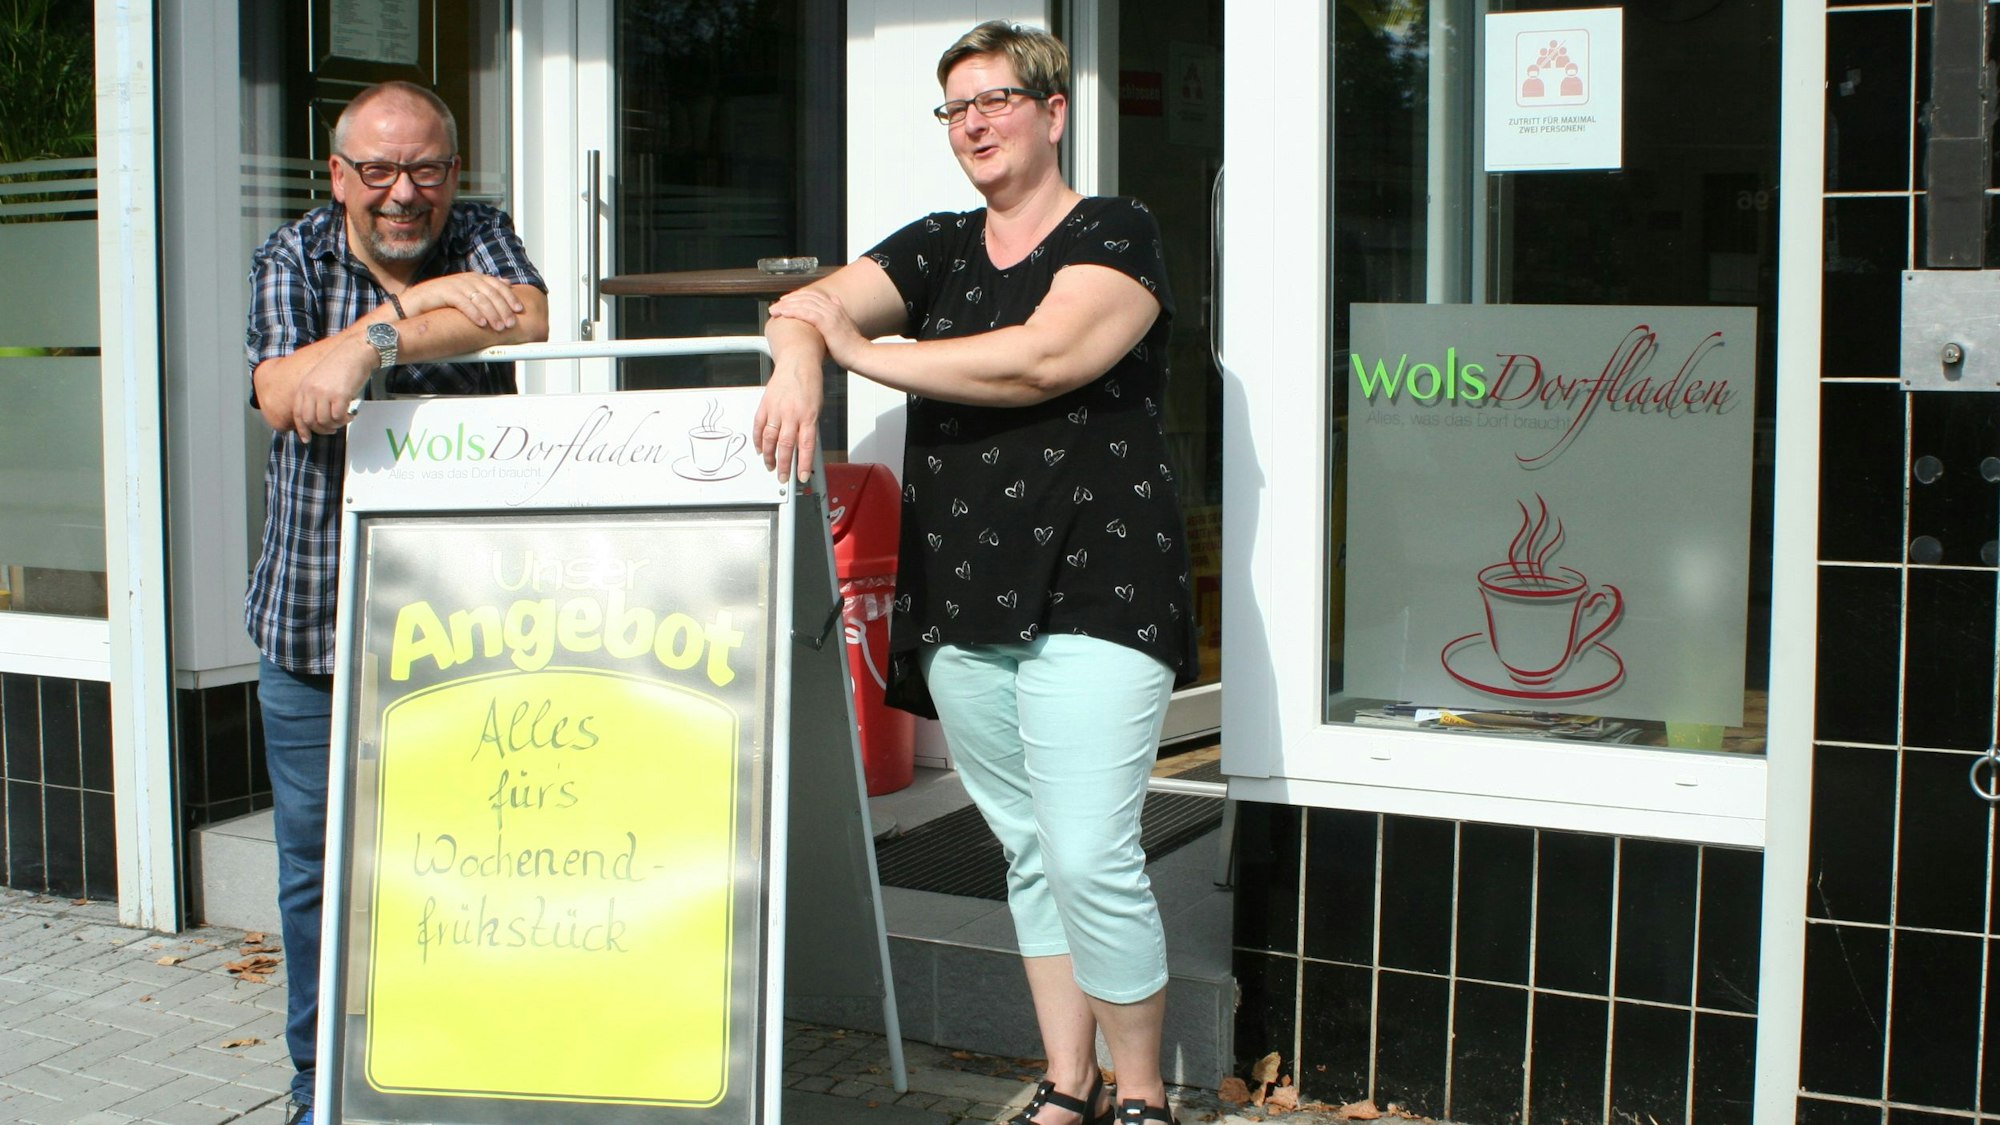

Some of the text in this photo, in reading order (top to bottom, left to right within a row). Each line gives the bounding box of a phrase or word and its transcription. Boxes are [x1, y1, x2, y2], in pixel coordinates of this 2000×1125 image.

[1508, 114, 1597, 126] ZUTRITT FÜR MAXIMAL
[1519, 124, 1586, 134] ZWEI PERSONEN!
[1410, 414, 1441, 426] was
[1444, 411, 1471, 427] das
[1477, 411, 1508, 427] Dorf
[421, 469, 444, 479] was
[447, 467, 468, 479] das
[472, 466, 496, 478] Dorf
[491, 549, 651, 593] Unser
[389, 589, 745, 688] Angebot
[471, 696, 600, 762] Alles
[417, 894, 630, 965] frühstück
